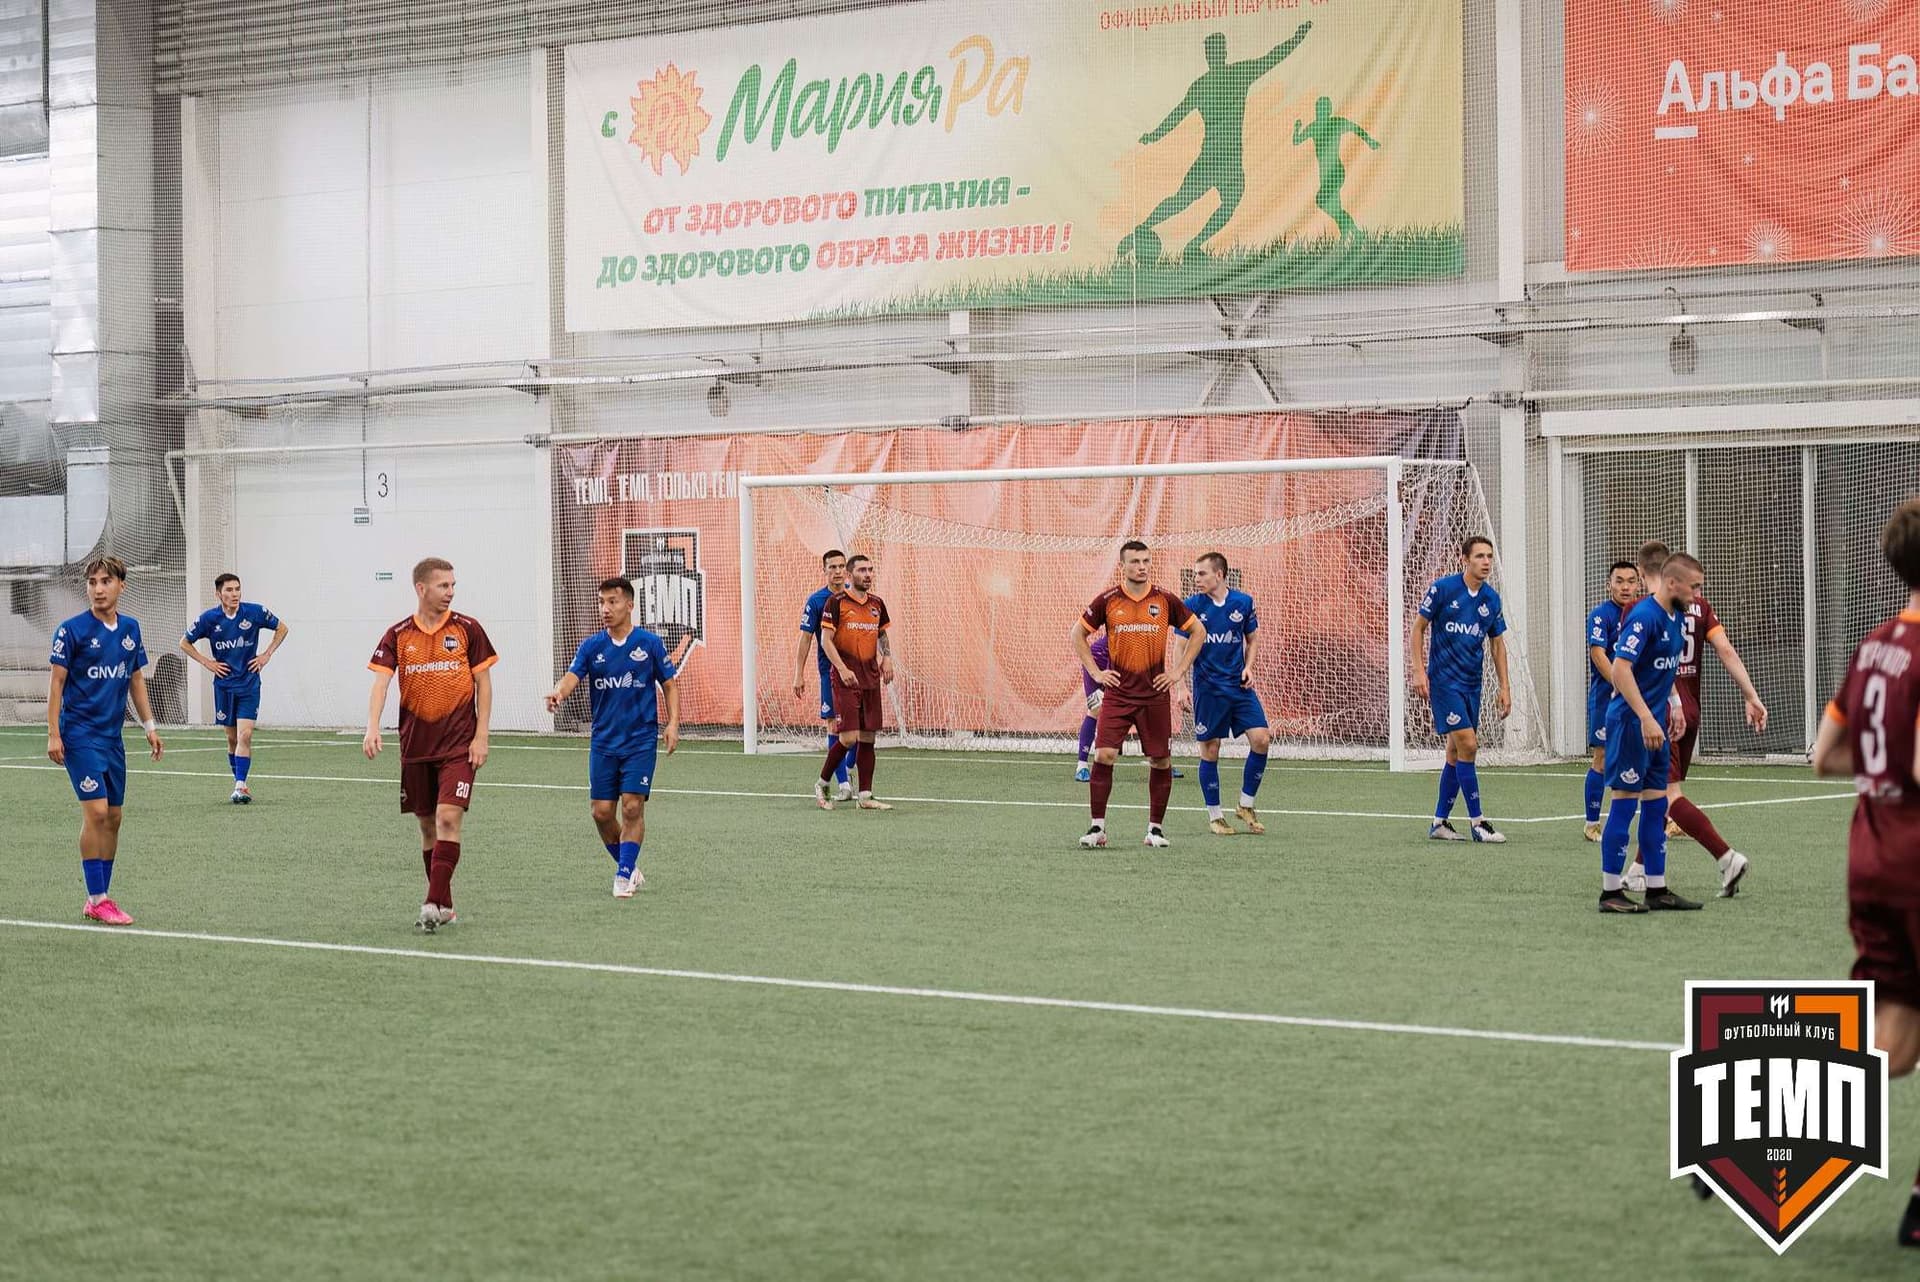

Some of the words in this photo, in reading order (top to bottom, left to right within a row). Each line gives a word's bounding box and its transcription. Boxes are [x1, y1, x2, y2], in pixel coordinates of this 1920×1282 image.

[1656, 50, 1834, 122] Альфа
[643, 206, 681, 235] ОТ
[684, 190, 858, 236] ЗДОРОВОГО
[864, 176, 1012, 218] ПИТАНИЯ
[596, 254, 637, 289] ДО
[641, 243, 811, 287] ЗДОРОВОГО
[816, 233, 931, 270] ОБРАЗА
[378, 472, 389, 498] 3
[657, 471, 707, 500] ТОЛЬКО
[711, 470, 741, 499] ТЕМ
[630, 574, 697, 630] ТЕМП
[1205, 633, 1225, 644] NV
[1445, 621, 1472, 635] GNV
[215, 639, 237, 651] GNV
[87, 665, 118, 679] GNV
[594, 676, 623, 690] GNV
[1860, 673, 1887, 776] 3
[456, 781, 470, 799] 20
